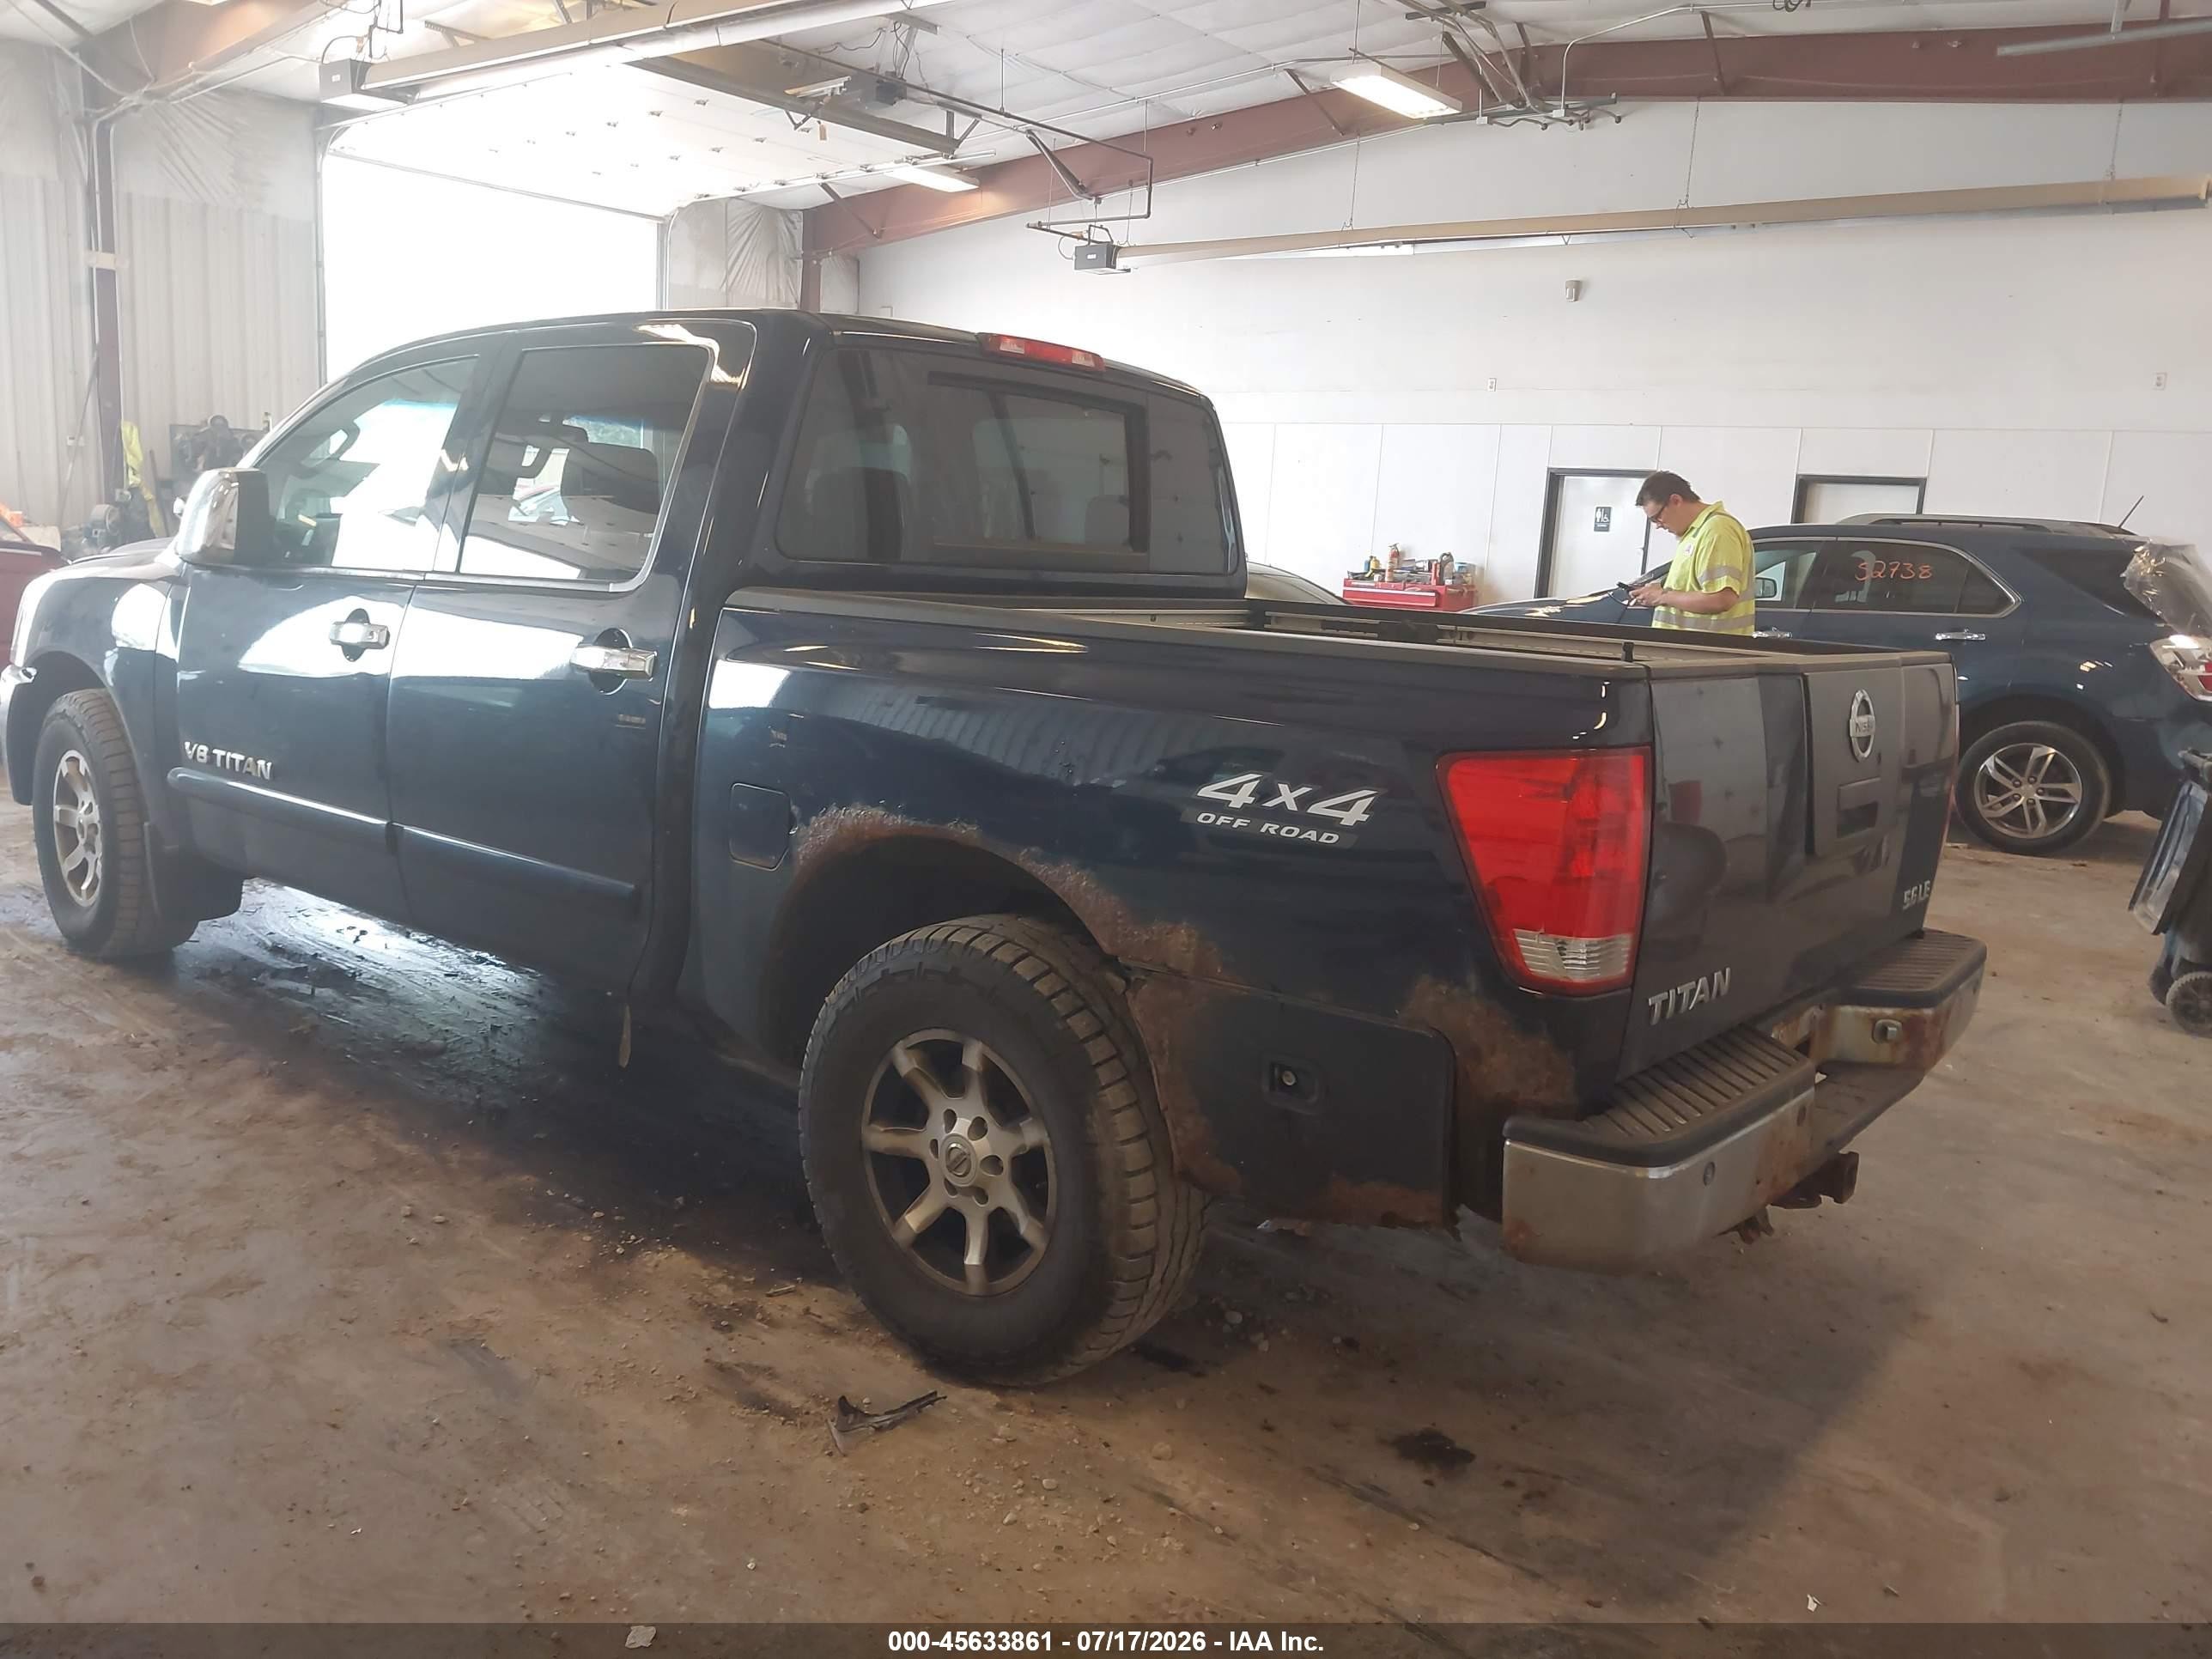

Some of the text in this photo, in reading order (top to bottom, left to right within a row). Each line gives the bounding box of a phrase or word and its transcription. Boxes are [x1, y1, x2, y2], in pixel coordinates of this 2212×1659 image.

[184, 740, 273, 781] V8 TITAN
[1196, 812, 1340, 845] OFF ROAD
[1648, 966, 1731, 1025] TITAN
